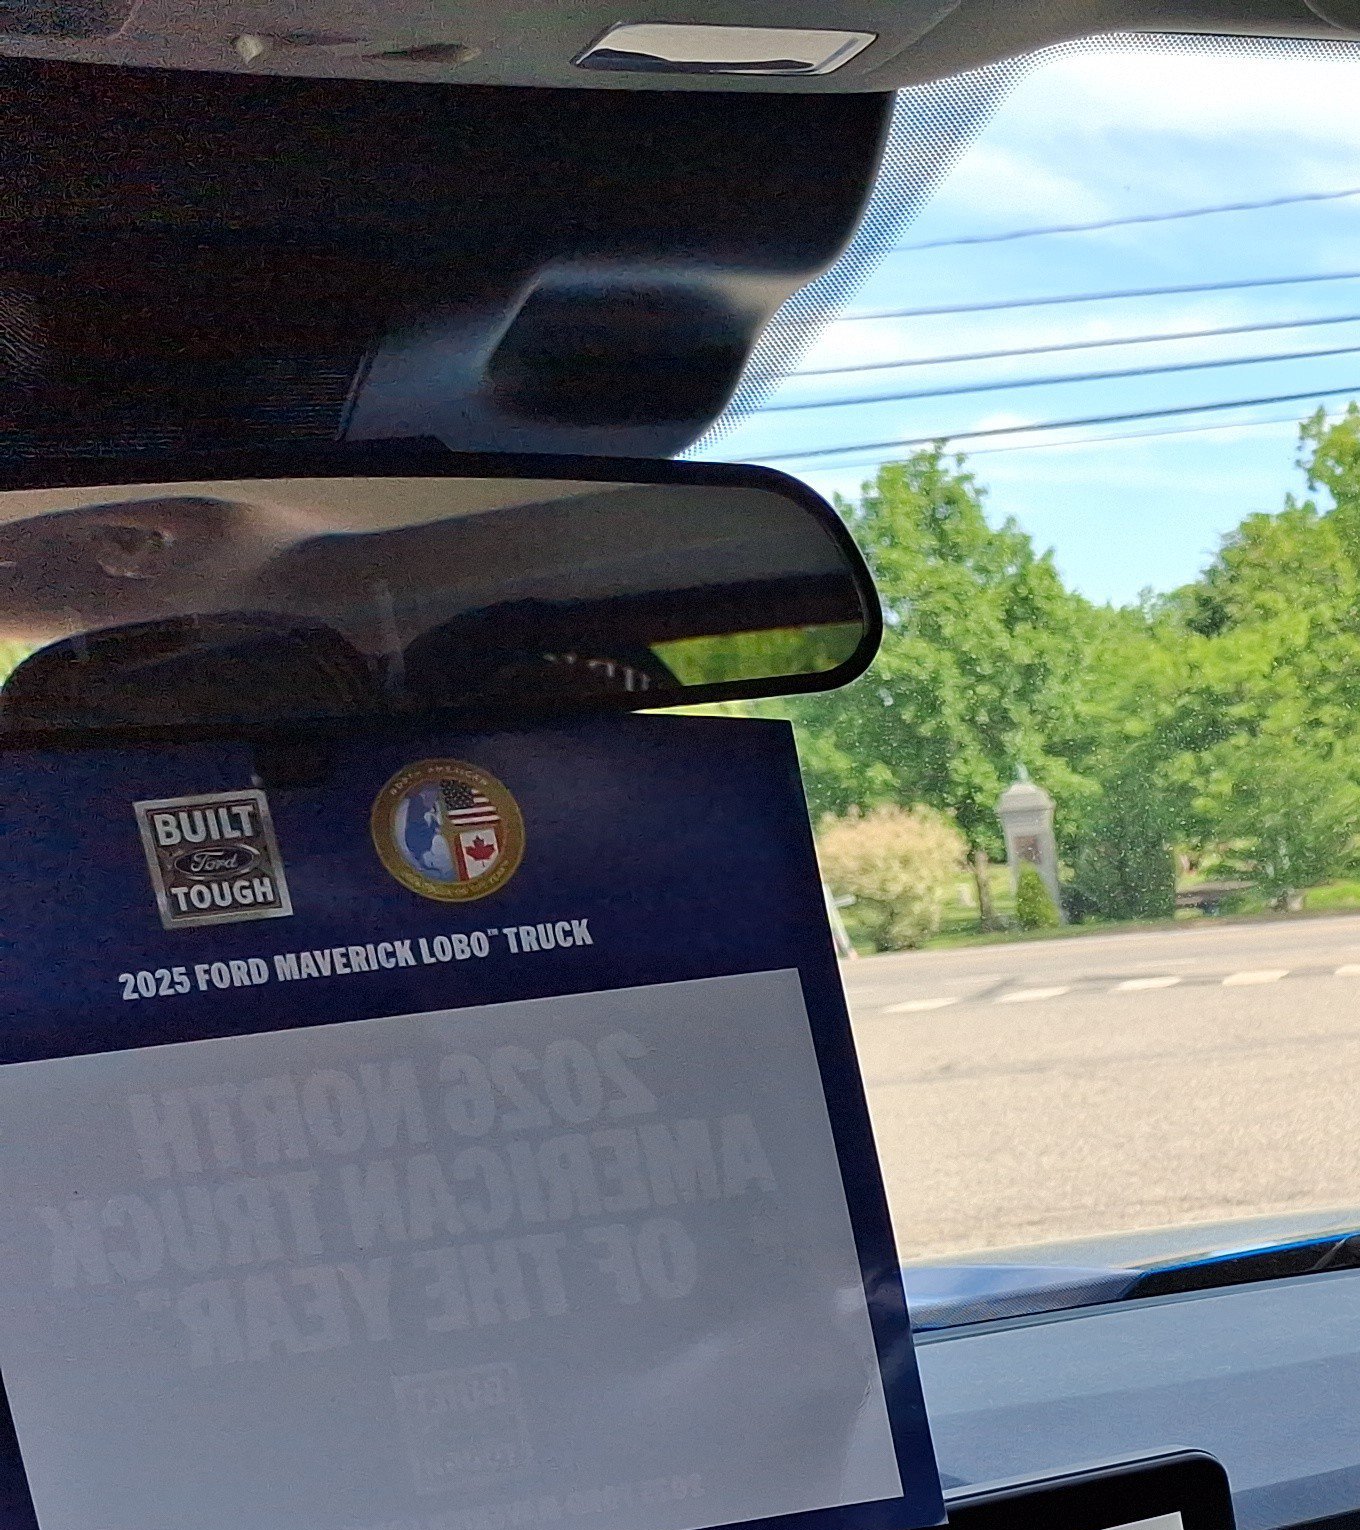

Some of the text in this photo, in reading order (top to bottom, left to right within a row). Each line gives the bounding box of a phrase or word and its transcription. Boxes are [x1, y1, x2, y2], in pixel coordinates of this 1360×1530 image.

[153, 805, 256, 846] BUILT
[190, 851, 238, 872] Ford
[171, 877, 274, 911] TOUGH
[118, 966, 191, 1001] 2025
[194, 957, 269, 991] FORD
[273, 939, 417, 982] MAVERICK
[503, 918, 594, 954] TRUCK
